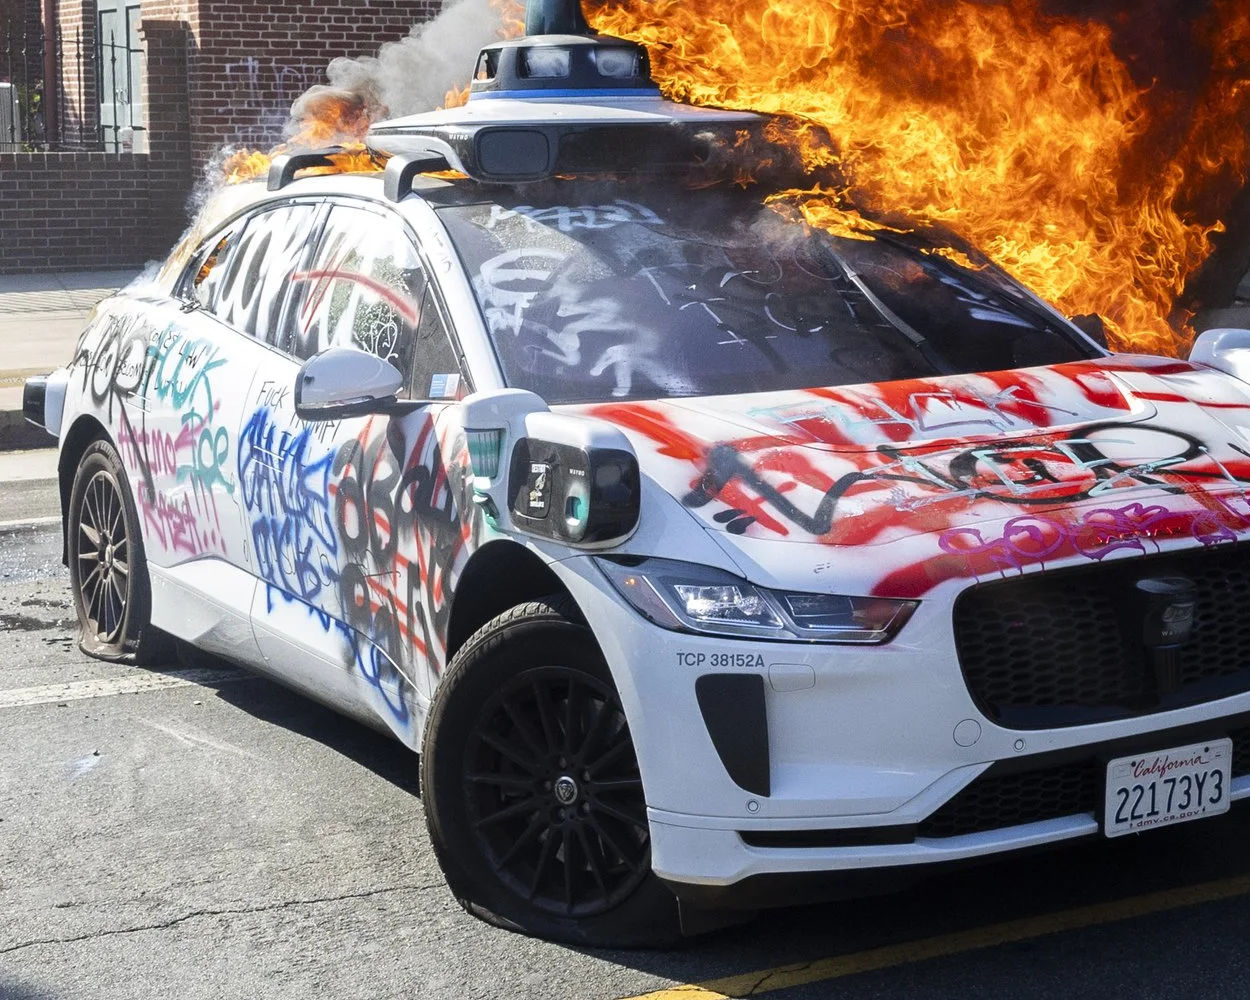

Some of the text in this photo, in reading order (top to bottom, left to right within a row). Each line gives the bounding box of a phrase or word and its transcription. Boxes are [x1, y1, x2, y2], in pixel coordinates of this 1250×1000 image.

[676, 652, 766, 668] TCP 38152A
[1133, 752, 1210, 779] California
[1115, 769, 1223, 825] 22173Y3
[1136, 809, 1200, 828] dmv.ca.gov
